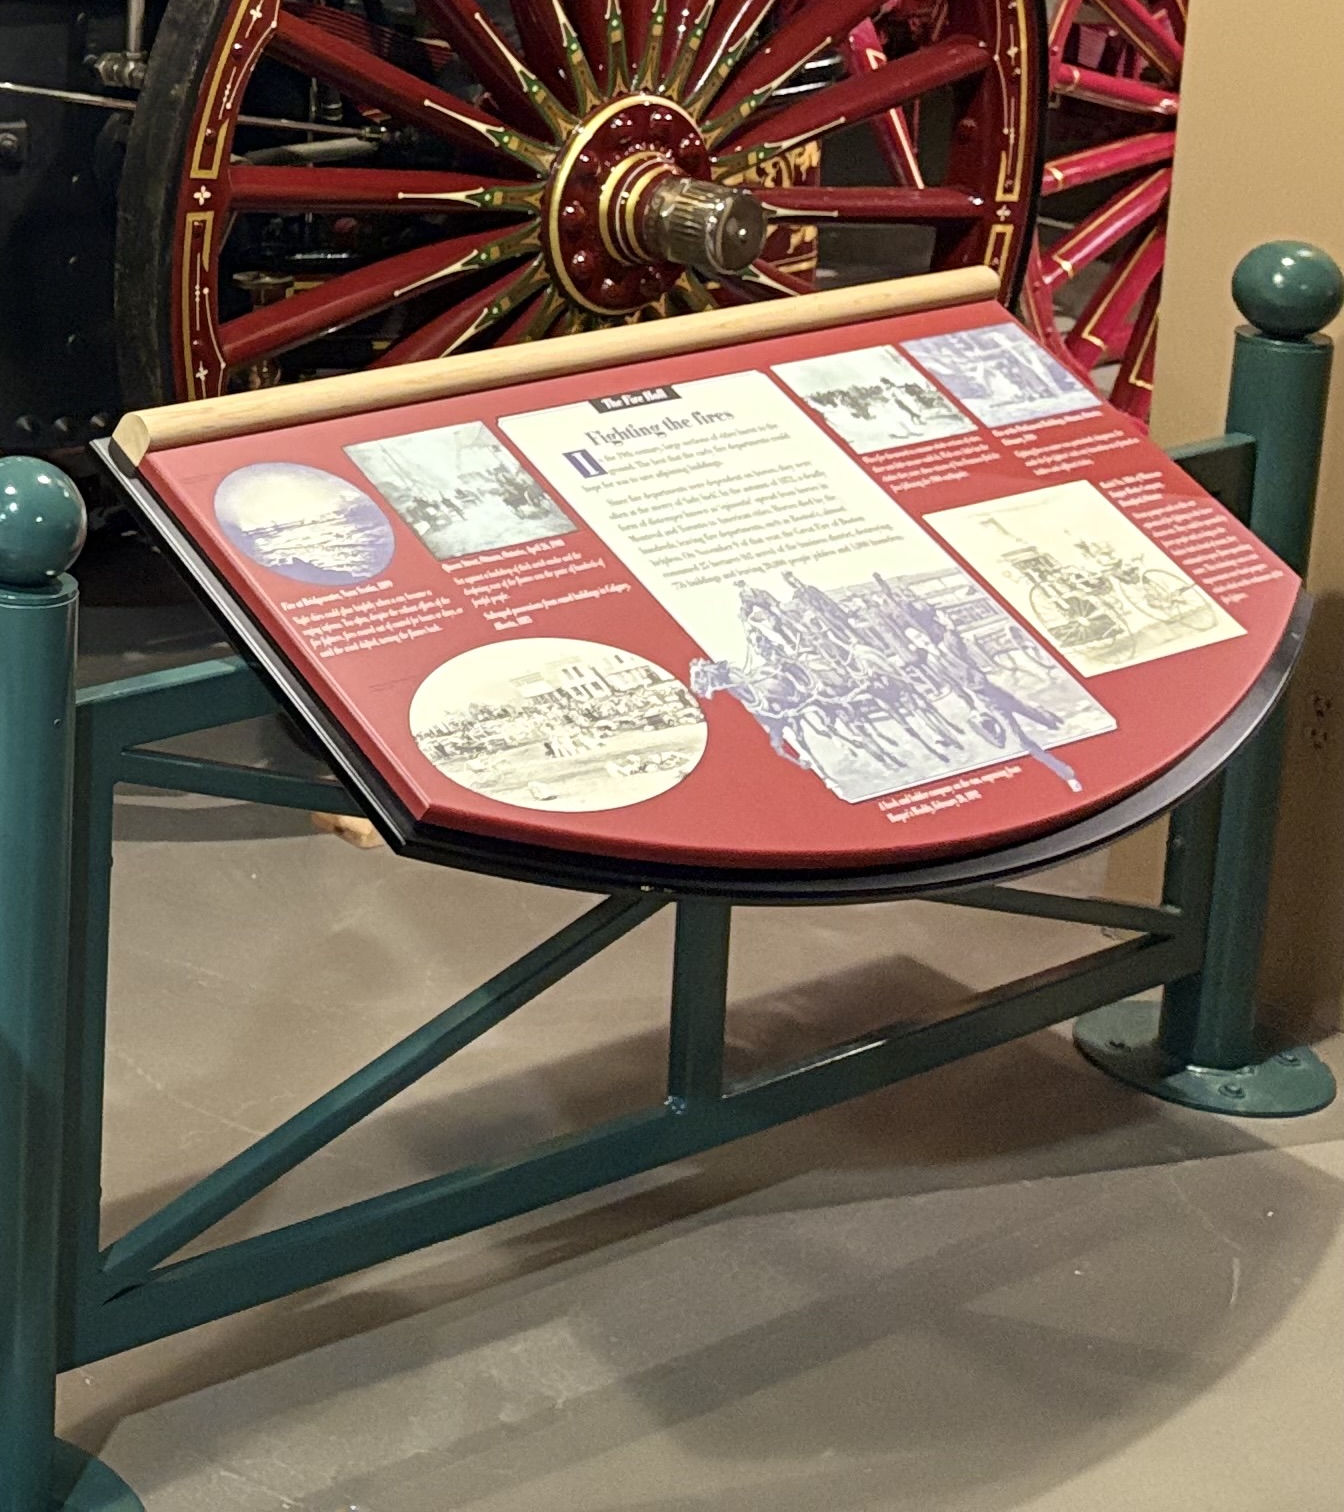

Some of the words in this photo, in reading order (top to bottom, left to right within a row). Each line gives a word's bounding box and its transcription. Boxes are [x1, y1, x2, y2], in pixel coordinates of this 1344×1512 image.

[585, 423, 666, 446] Fighting
[662, 416, 690, 430] the
[691, 410, 734, 425] fires
